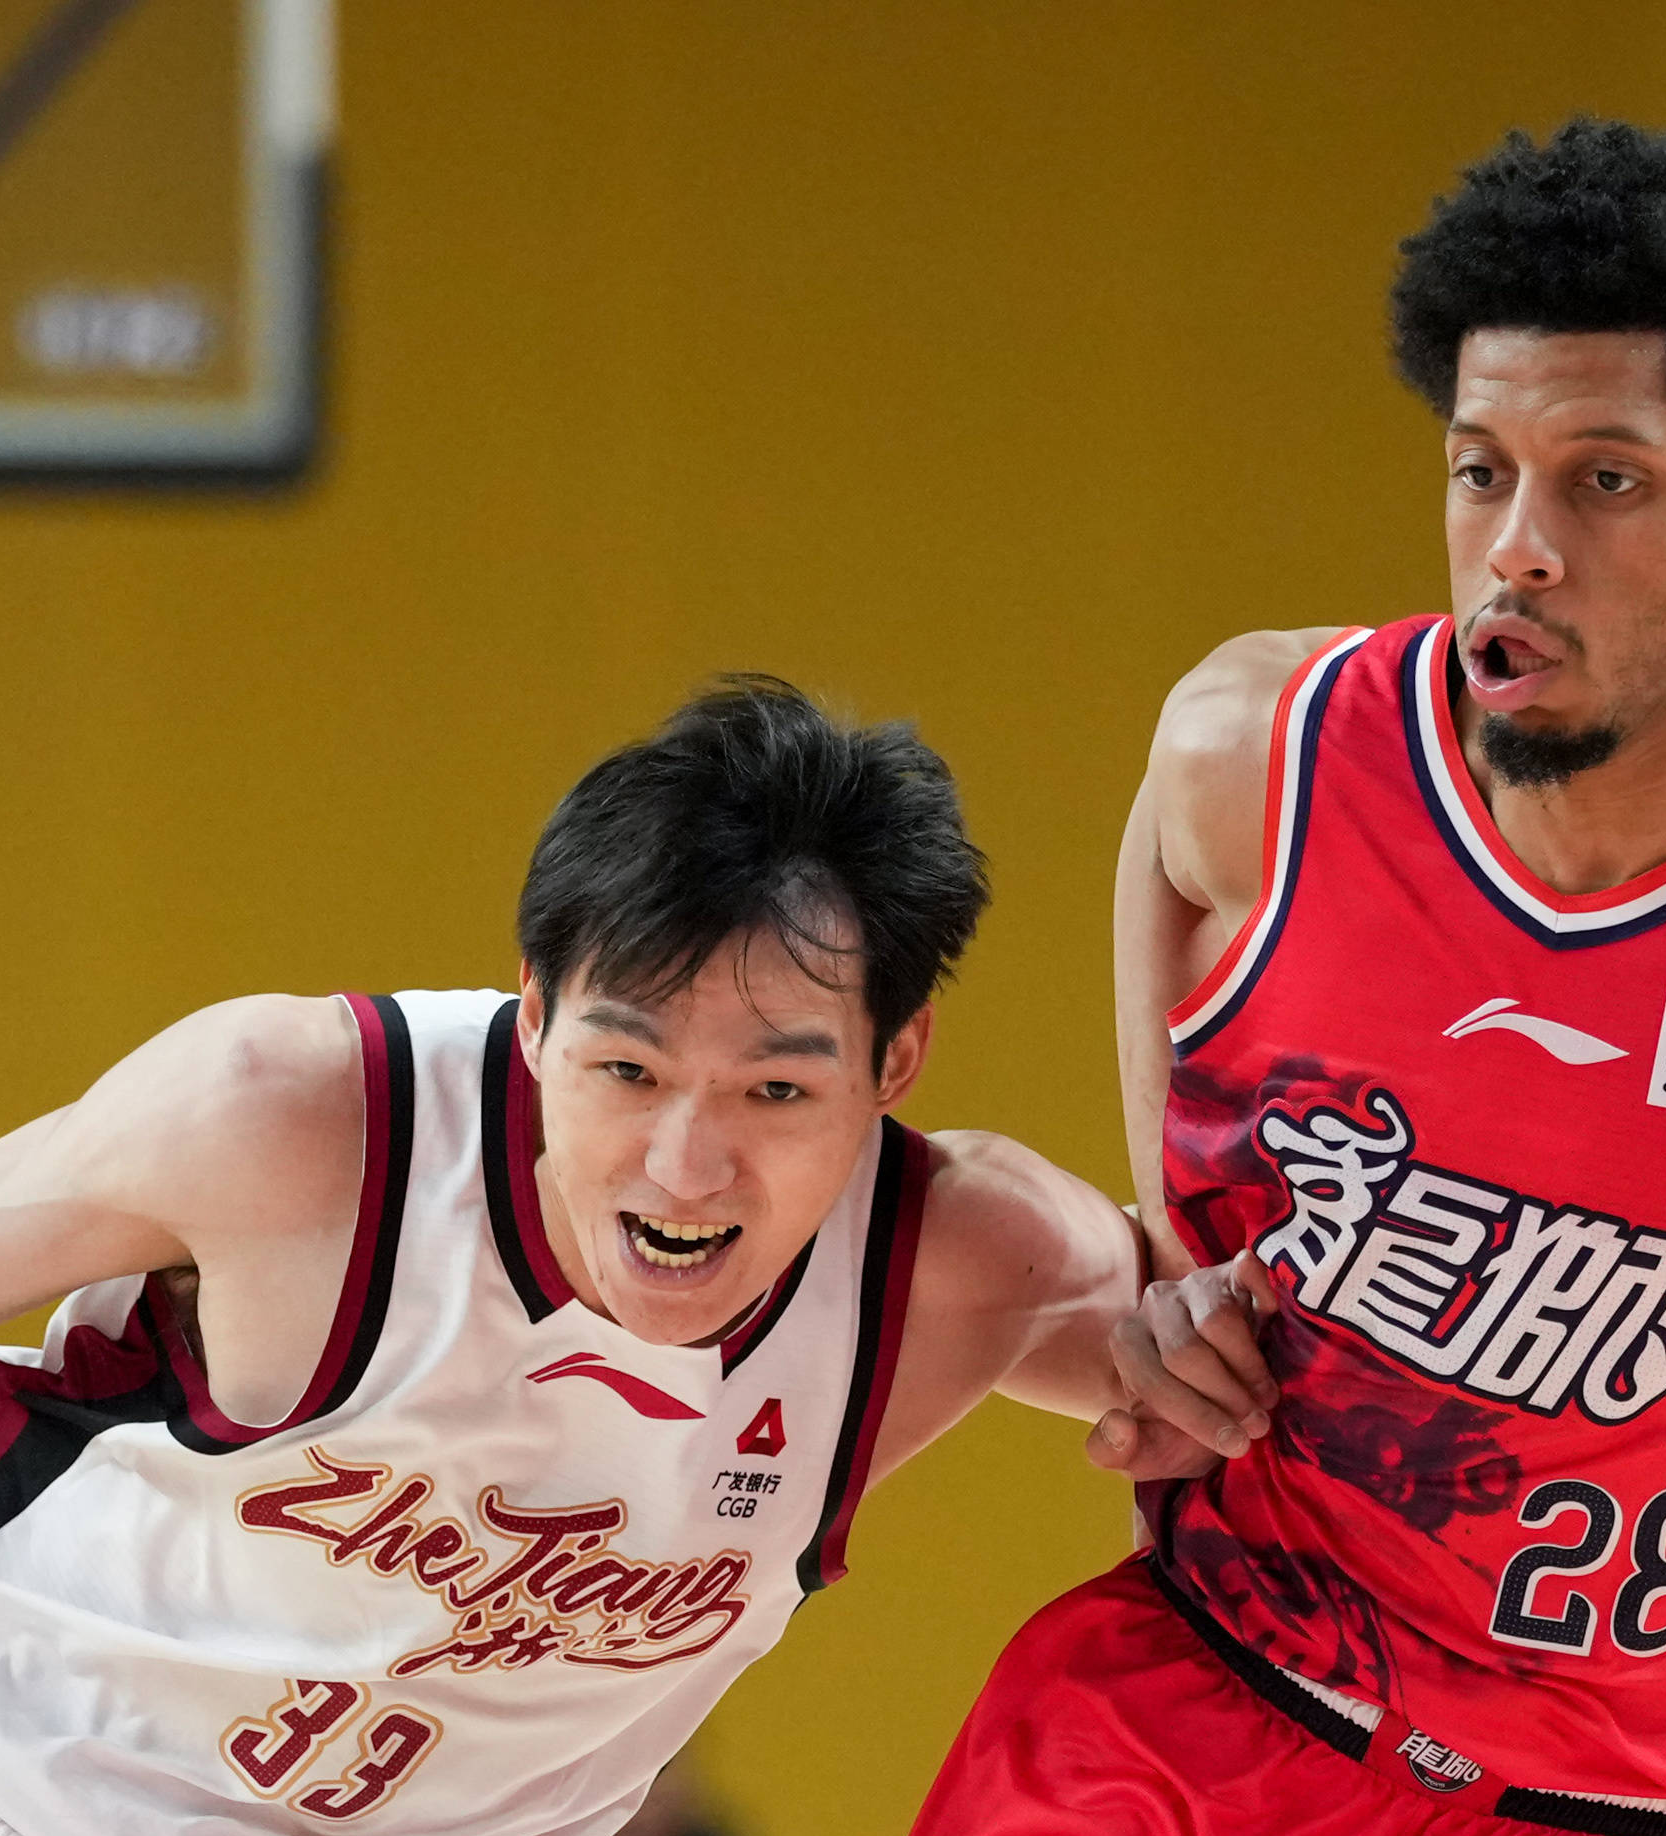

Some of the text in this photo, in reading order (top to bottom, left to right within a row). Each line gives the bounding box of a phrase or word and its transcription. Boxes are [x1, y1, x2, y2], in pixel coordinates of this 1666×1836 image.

[712, 1470, 782, 1494] 广发银行
[717, 1496, 758, 1518] CGB
[222, 1679, 442, 1820] 33
